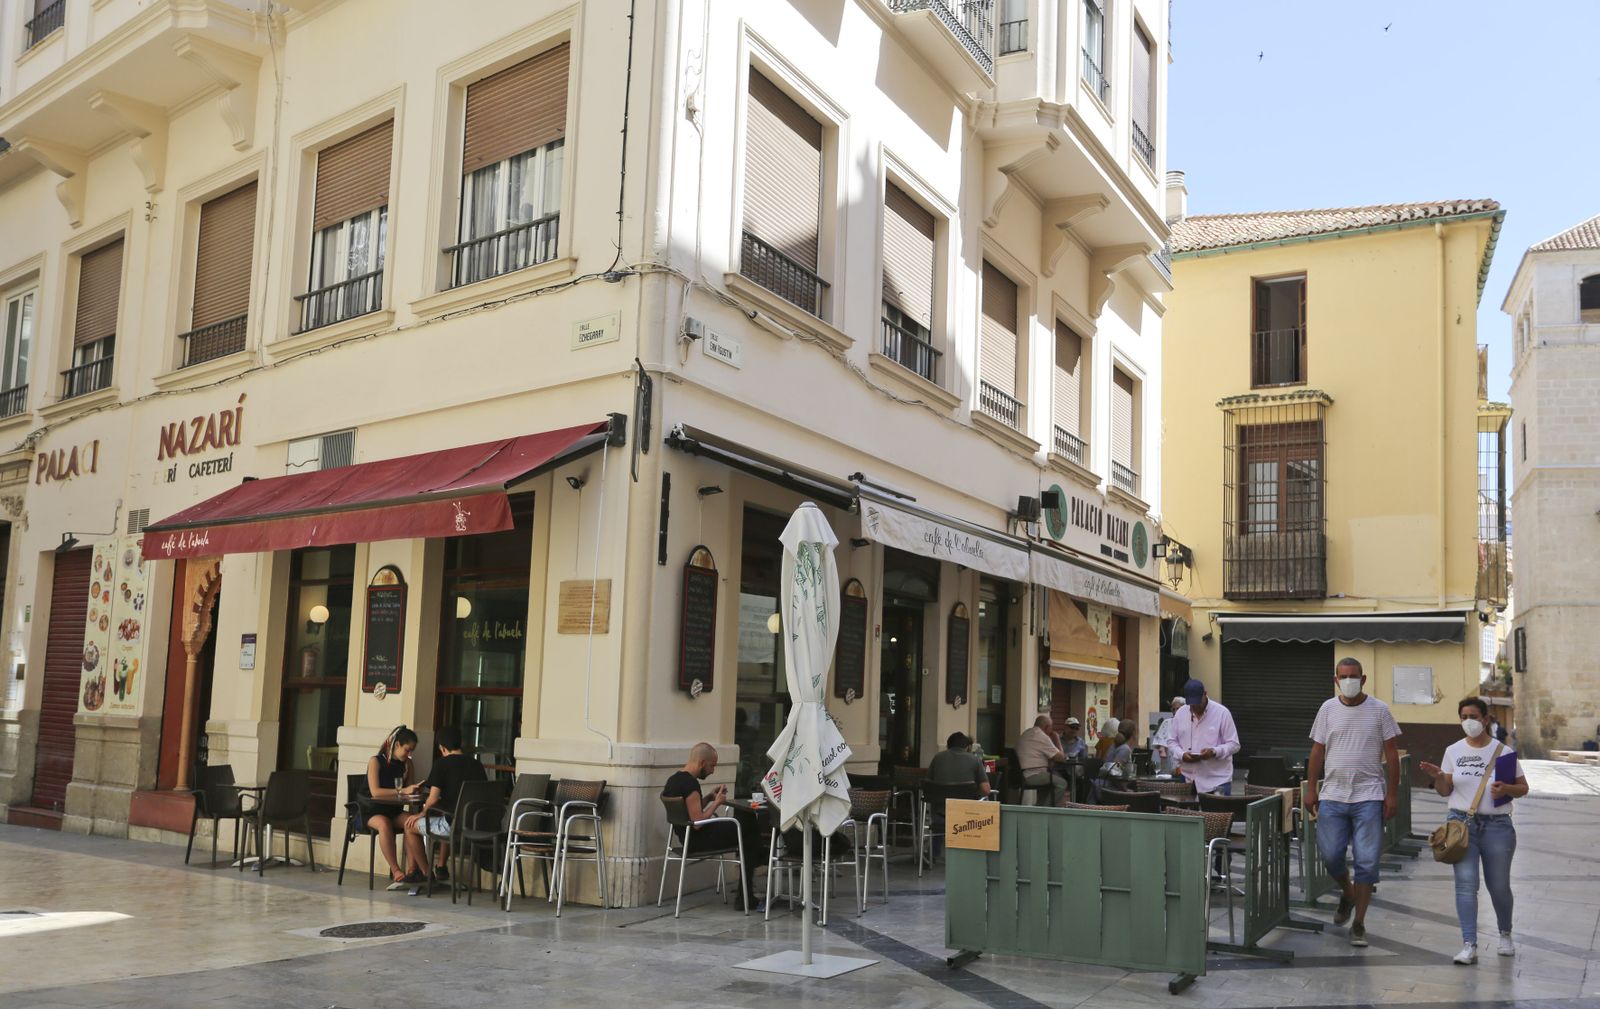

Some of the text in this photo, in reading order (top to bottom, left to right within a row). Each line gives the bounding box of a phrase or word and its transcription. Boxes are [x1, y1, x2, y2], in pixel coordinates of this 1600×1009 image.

[157, 393, 247, 461] NAZARÍ
[1071, 496, 1103, 537] PALACIO
[178, 532, 187, 551] de
[945, 531, 954, 555] de
